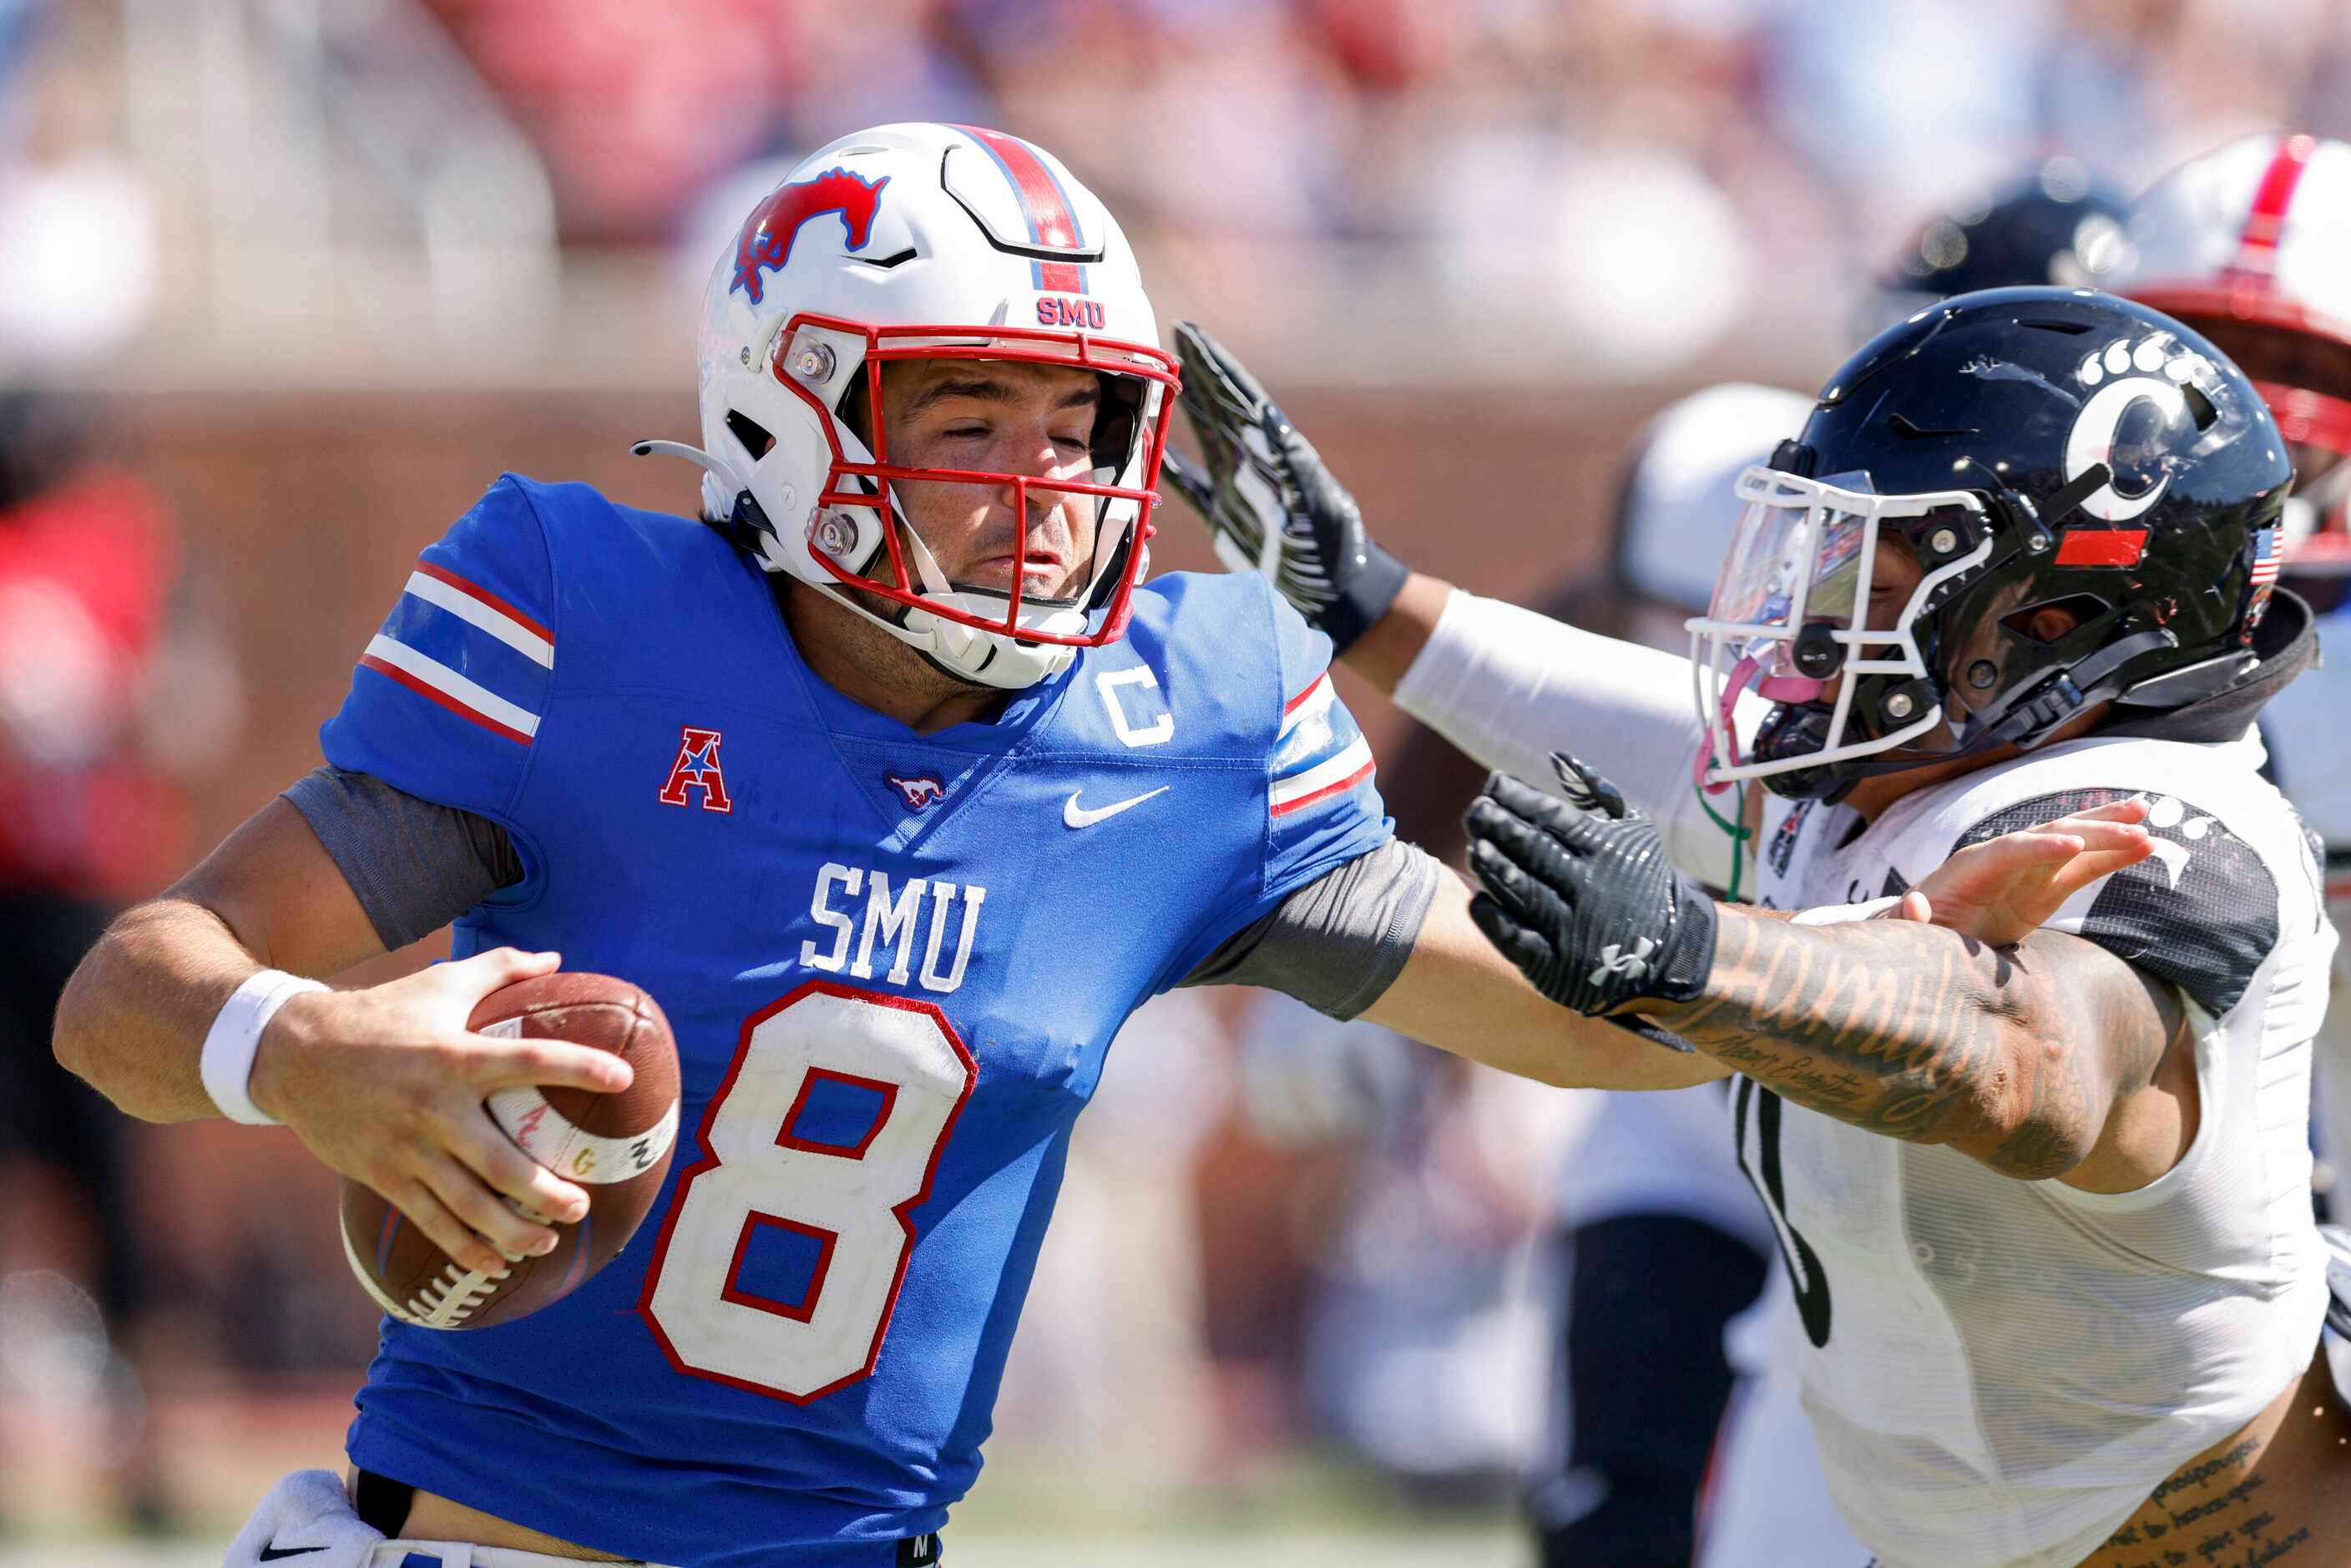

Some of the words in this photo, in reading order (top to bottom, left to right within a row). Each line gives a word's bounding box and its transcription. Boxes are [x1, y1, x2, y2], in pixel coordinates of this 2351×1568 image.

[1037, 297, 1106, 330] SMU
[1095, 665, 1175, 748] C
[660, 726, 732, 815] A
[799, 862, 987, 994] SMU
[636, 980, 979, 1406] 8
